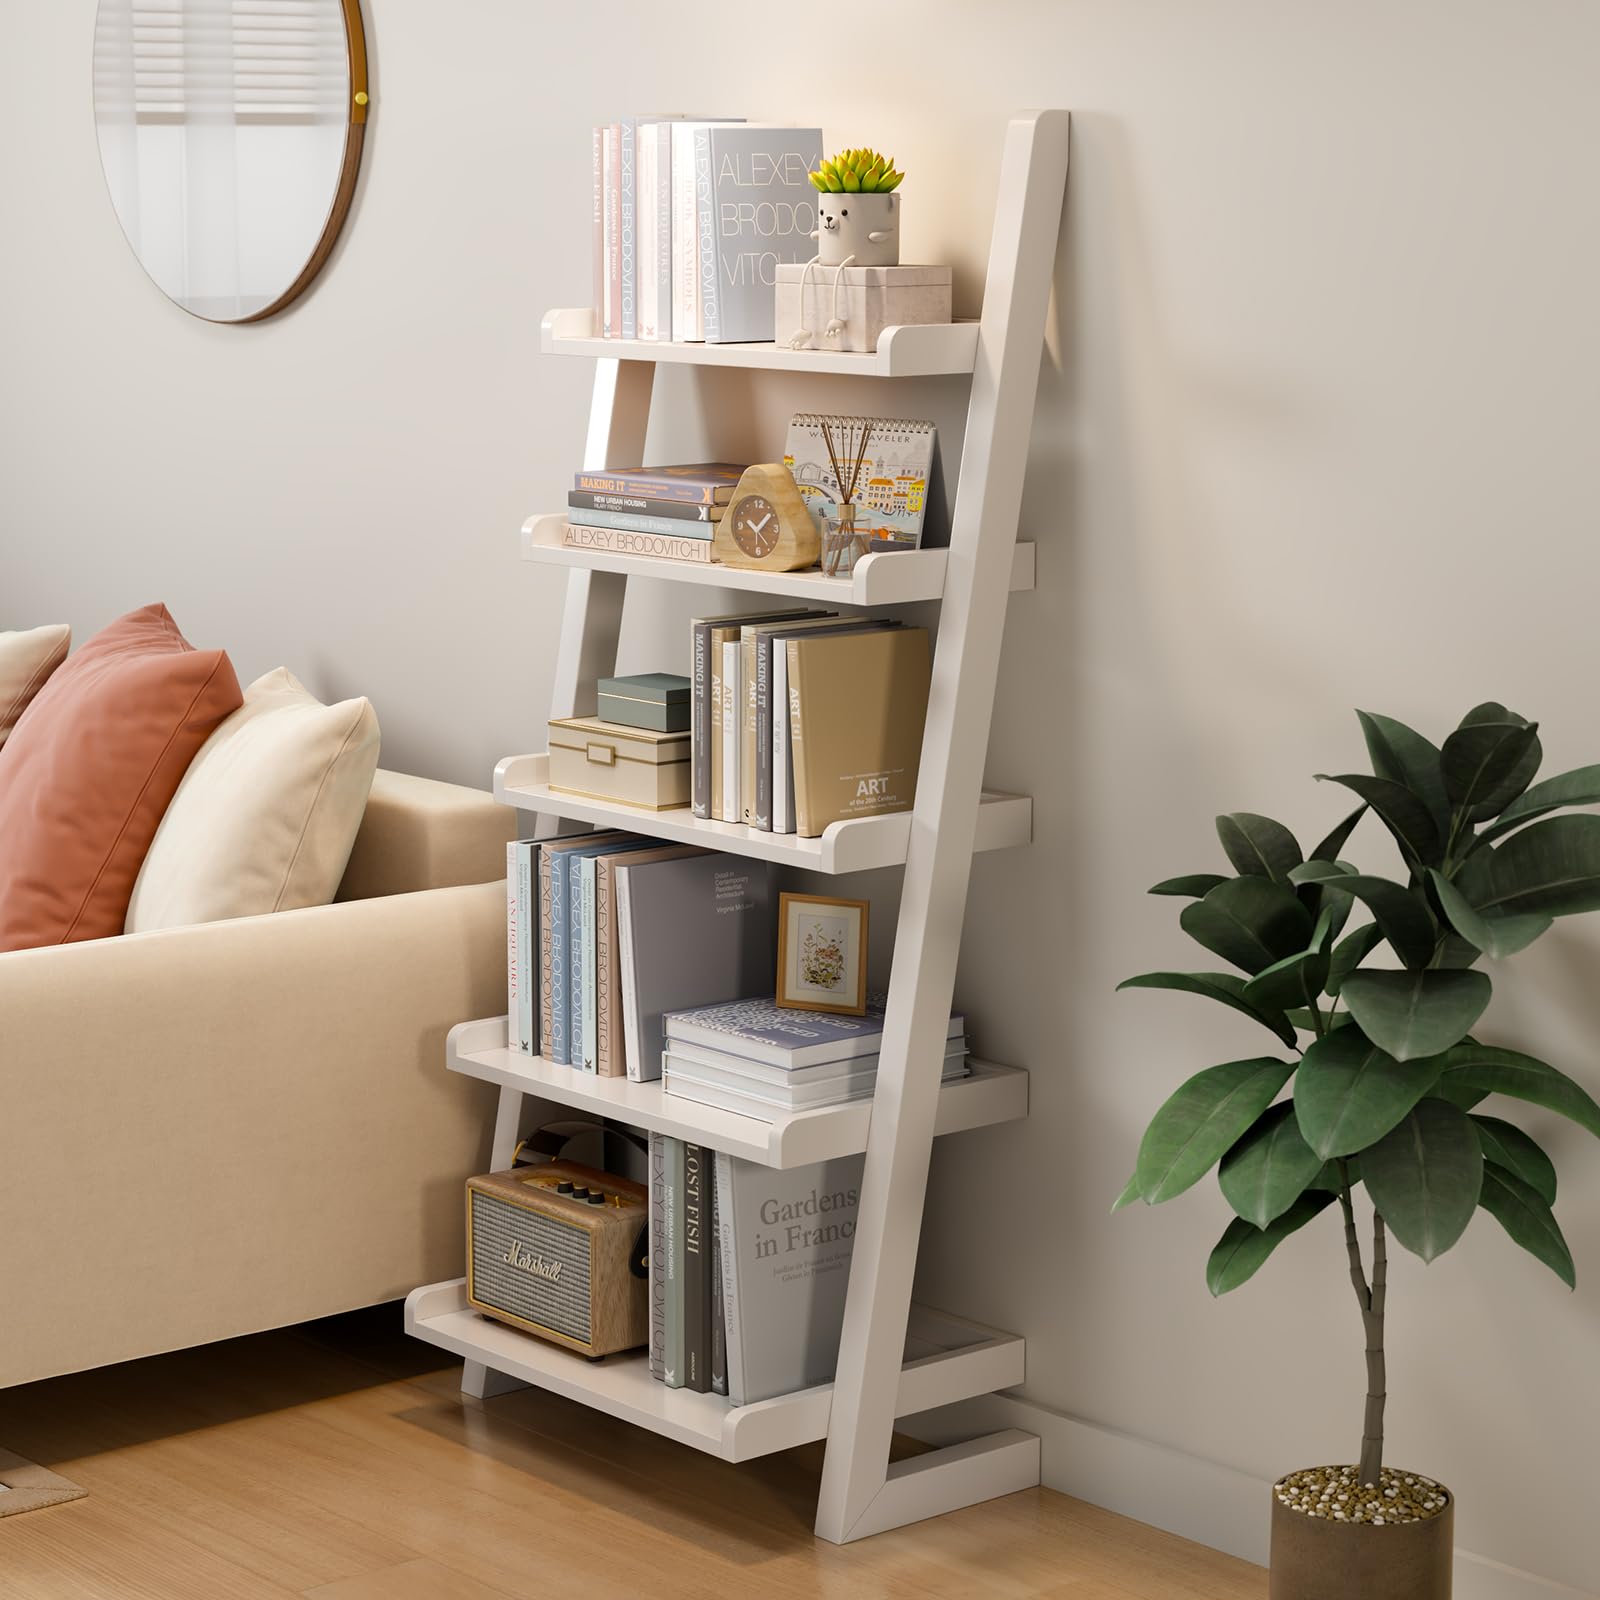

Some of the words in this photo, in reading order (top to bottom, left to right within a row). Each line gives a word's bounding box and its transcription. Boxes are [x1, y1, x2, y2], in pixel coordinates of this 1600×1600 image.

[622, 124, 633, 197] ALEXEY
[695, 135, 711, 205] ALEXEY
[718, 152, 818, 187] ALEXEY
[622, 203, 633, 325] BRODOVITCH
[700, 211, 718, 330] BRODOVITCH
[722, 251, 797, 286] VITC
[855, 432, 911, 444] TAVELER
[580, 476, 615, 491] MAKING
[615, 480, 626, 492] IT
[593, 495, 606, 503] NEW
[606, 496, 623, 505] URBAN
[624, 498, 647, 509] HOUSING
[754, 500, 764, 509] 12
[565, 528, 614, 548] ALEXEY
[616, 533, 700, 559] BRODOVITCH
[737, 521, 744, 530] 9
[772, 524, 779, 534] 3
[756, 547, 762, 556] 6
[695, 633, 704, 683] MAKING
[757, 642, 767, 692] MAKING
[695, 684, 704, 698] IT
[712, 673, 721, 705] ART
[723, 685, 733, 714] ART
[749, 679, 757, 709] ART
[757, 694, 767, 709] IT
[789, 686, 801, 720] ART
[856, 776, 889, 798] ART
[542, 850, 551, 922] ALEXEY
[598, 862, 608, 937] ALEXEY
[543, 927, 552, 1047] BRODOVITCH
[599, 941, 609, 1063] BRODOVITCH
[687, 1143, 700, 1201] LOST
[760, 1188, 858, 1225] Gardens
[687, 1204, 700, 1256] FISH
[754, 1233, 779, 1260] in
[783, 1220, 857, 1252] Franc
[503, 1239, 562, 1281] Marshall
[722, 1223, 732, 1277] Gardens
[725, 1293, 736, 1336] France
